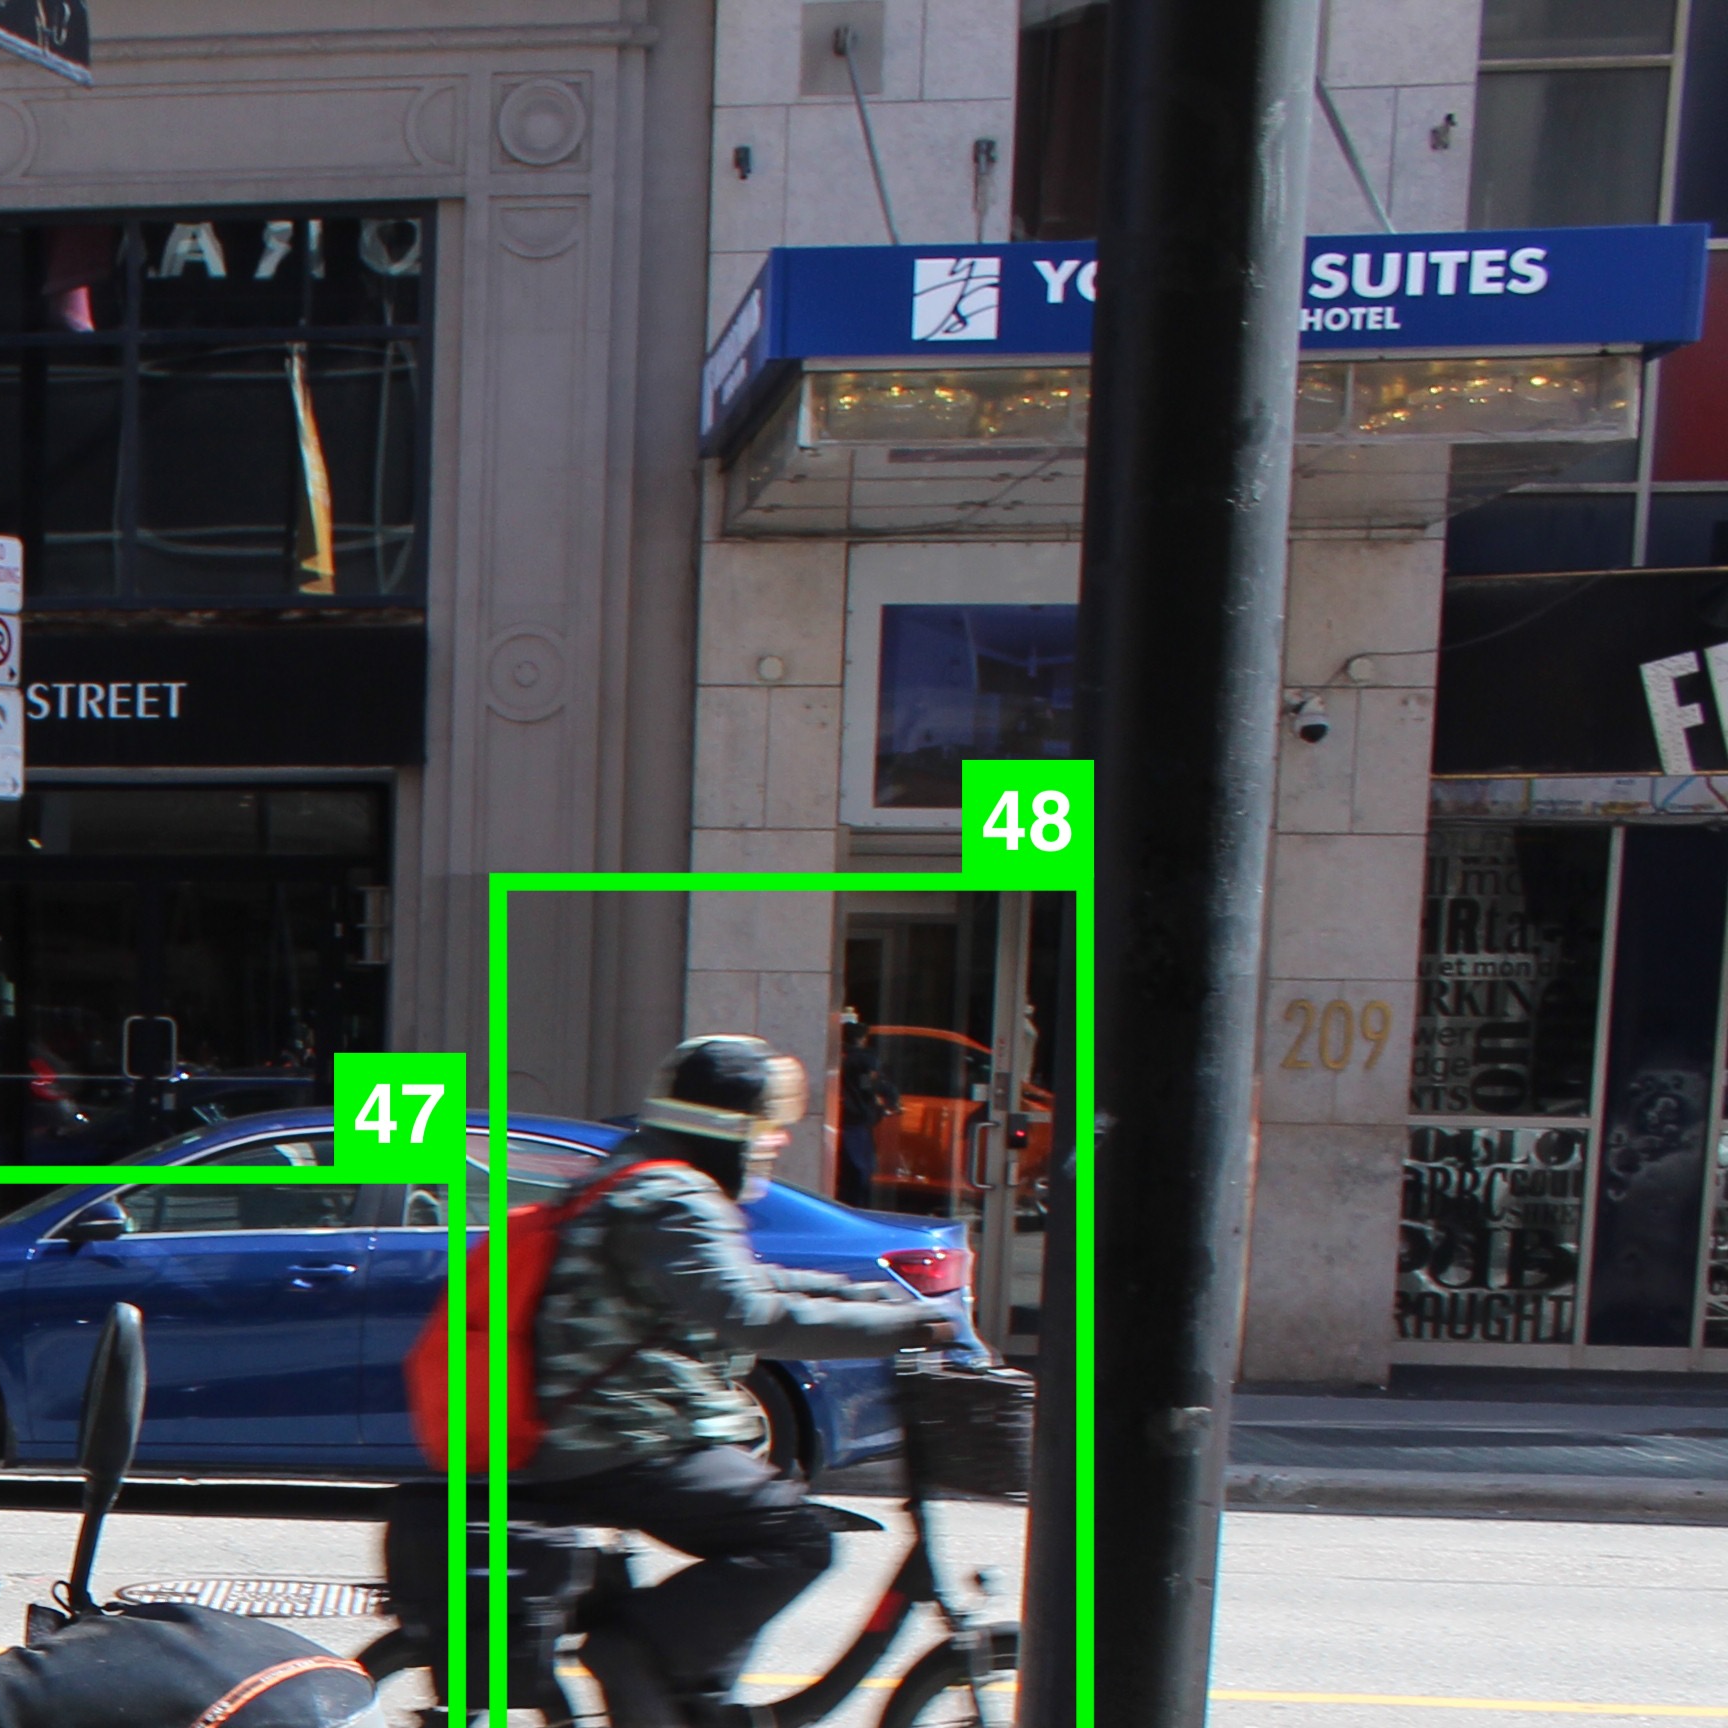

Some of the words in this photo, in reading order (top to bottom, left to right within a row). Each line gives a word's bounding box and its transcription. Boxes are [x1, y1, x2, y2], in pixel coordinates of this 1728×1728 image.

[1308, 247, 1549, 299] SUITES
[1299, 307, 1401, 331] HOTEL
[26, 682, 187, 719] STREET
[1279, 998, 1392, 1071] 209
